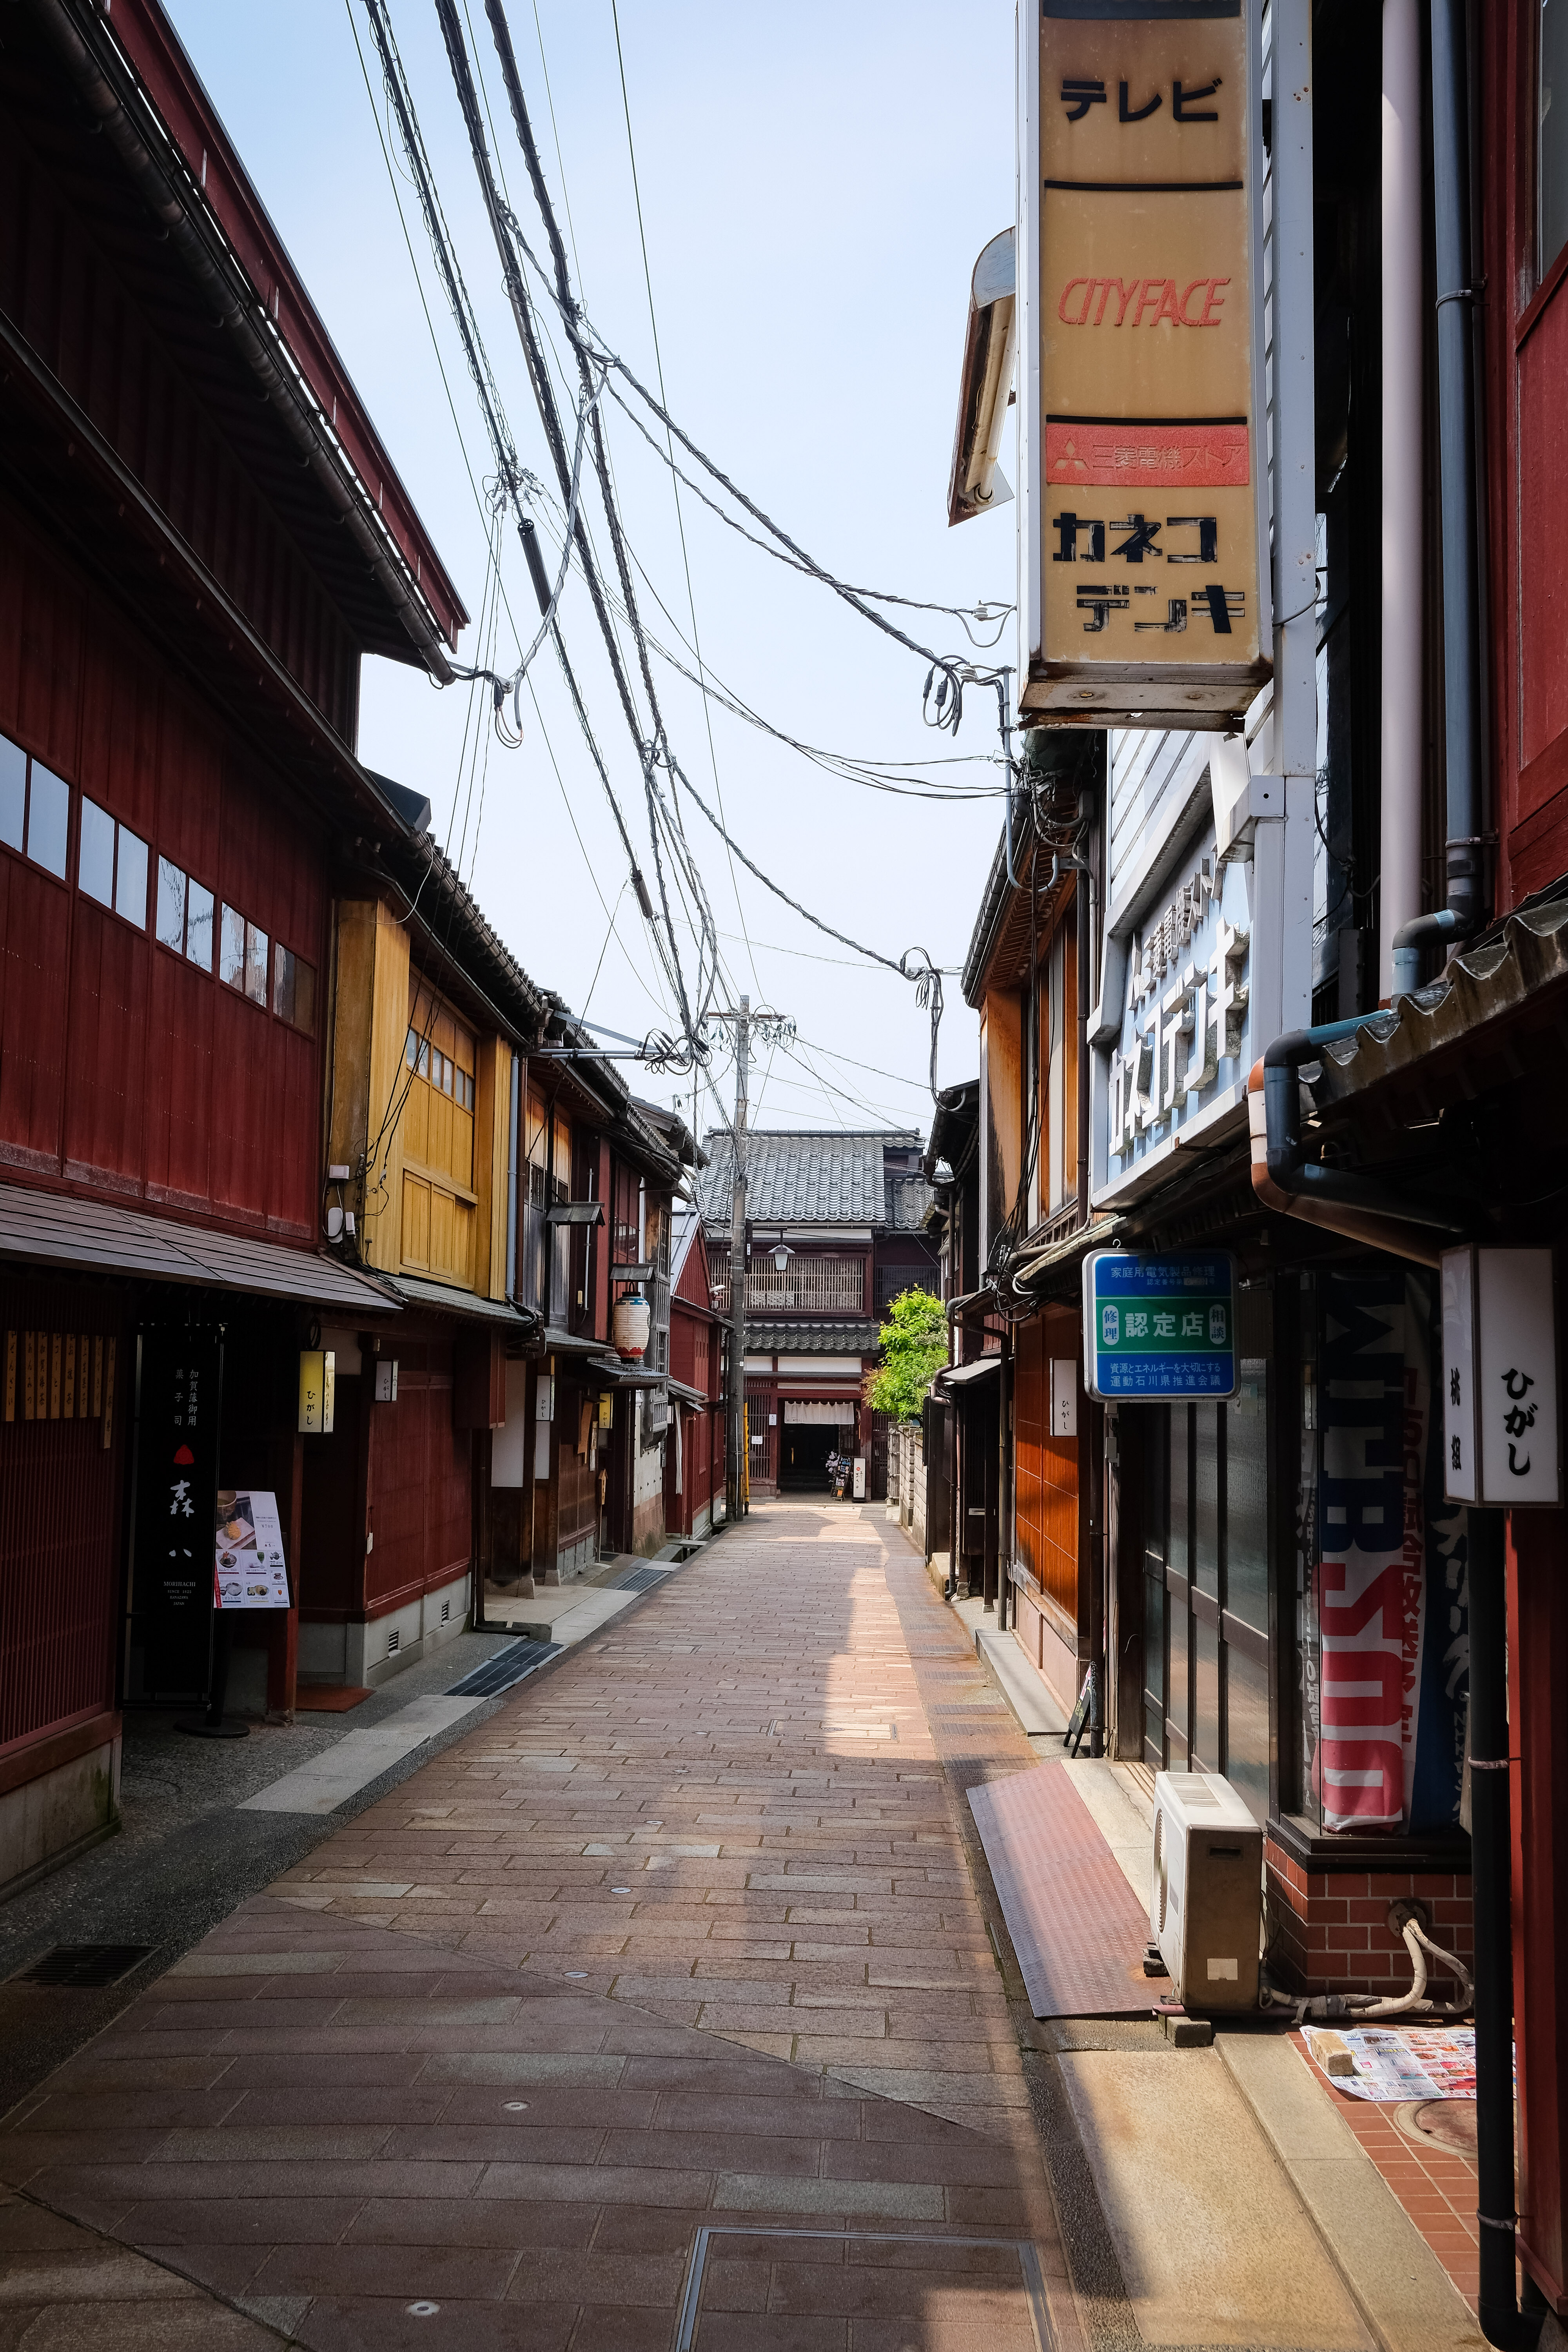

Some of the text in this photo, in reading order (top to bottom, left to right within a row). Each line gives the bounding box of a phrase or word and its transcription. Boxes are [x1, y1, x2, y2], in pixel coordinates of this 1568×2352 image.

[1060, 78, 1223, 122] テレビ
[1058, 277, 1231, 327] CITYFACE
[1092, 443, 1245, 472] 三菱電機ストア
[1053, 512, 1218, 563] カネコ
[1076, 584, 1245, 634] デンキ
[1109, 915, 1250, 1157] カネコデンキ
[1111, 1266, 1215, 1278] 家庭用電気製品修理
[1103, 1310, 1118, 1340] 修理
[1125, 1312, 1204, 1338] 認定店
[1210, 1308, 1225, 1340] 相談
[1110, 1362, 1221, 1374] 資源とエネルギーを大切にする
[1110, 1375, 1221, 1387] 運動石川県推進会議
[174, 1369, 184, 1426] 菓子司
[187, 1369, 199, 1426] 加賀藩御用
[306, 1391, 316, 1425] ひがし
[1062, 1400, 1070, 1430] ひがし
[1500, 1368, 1538, 1476] ひがし
[169, 1480, 194, 1557] 森八
